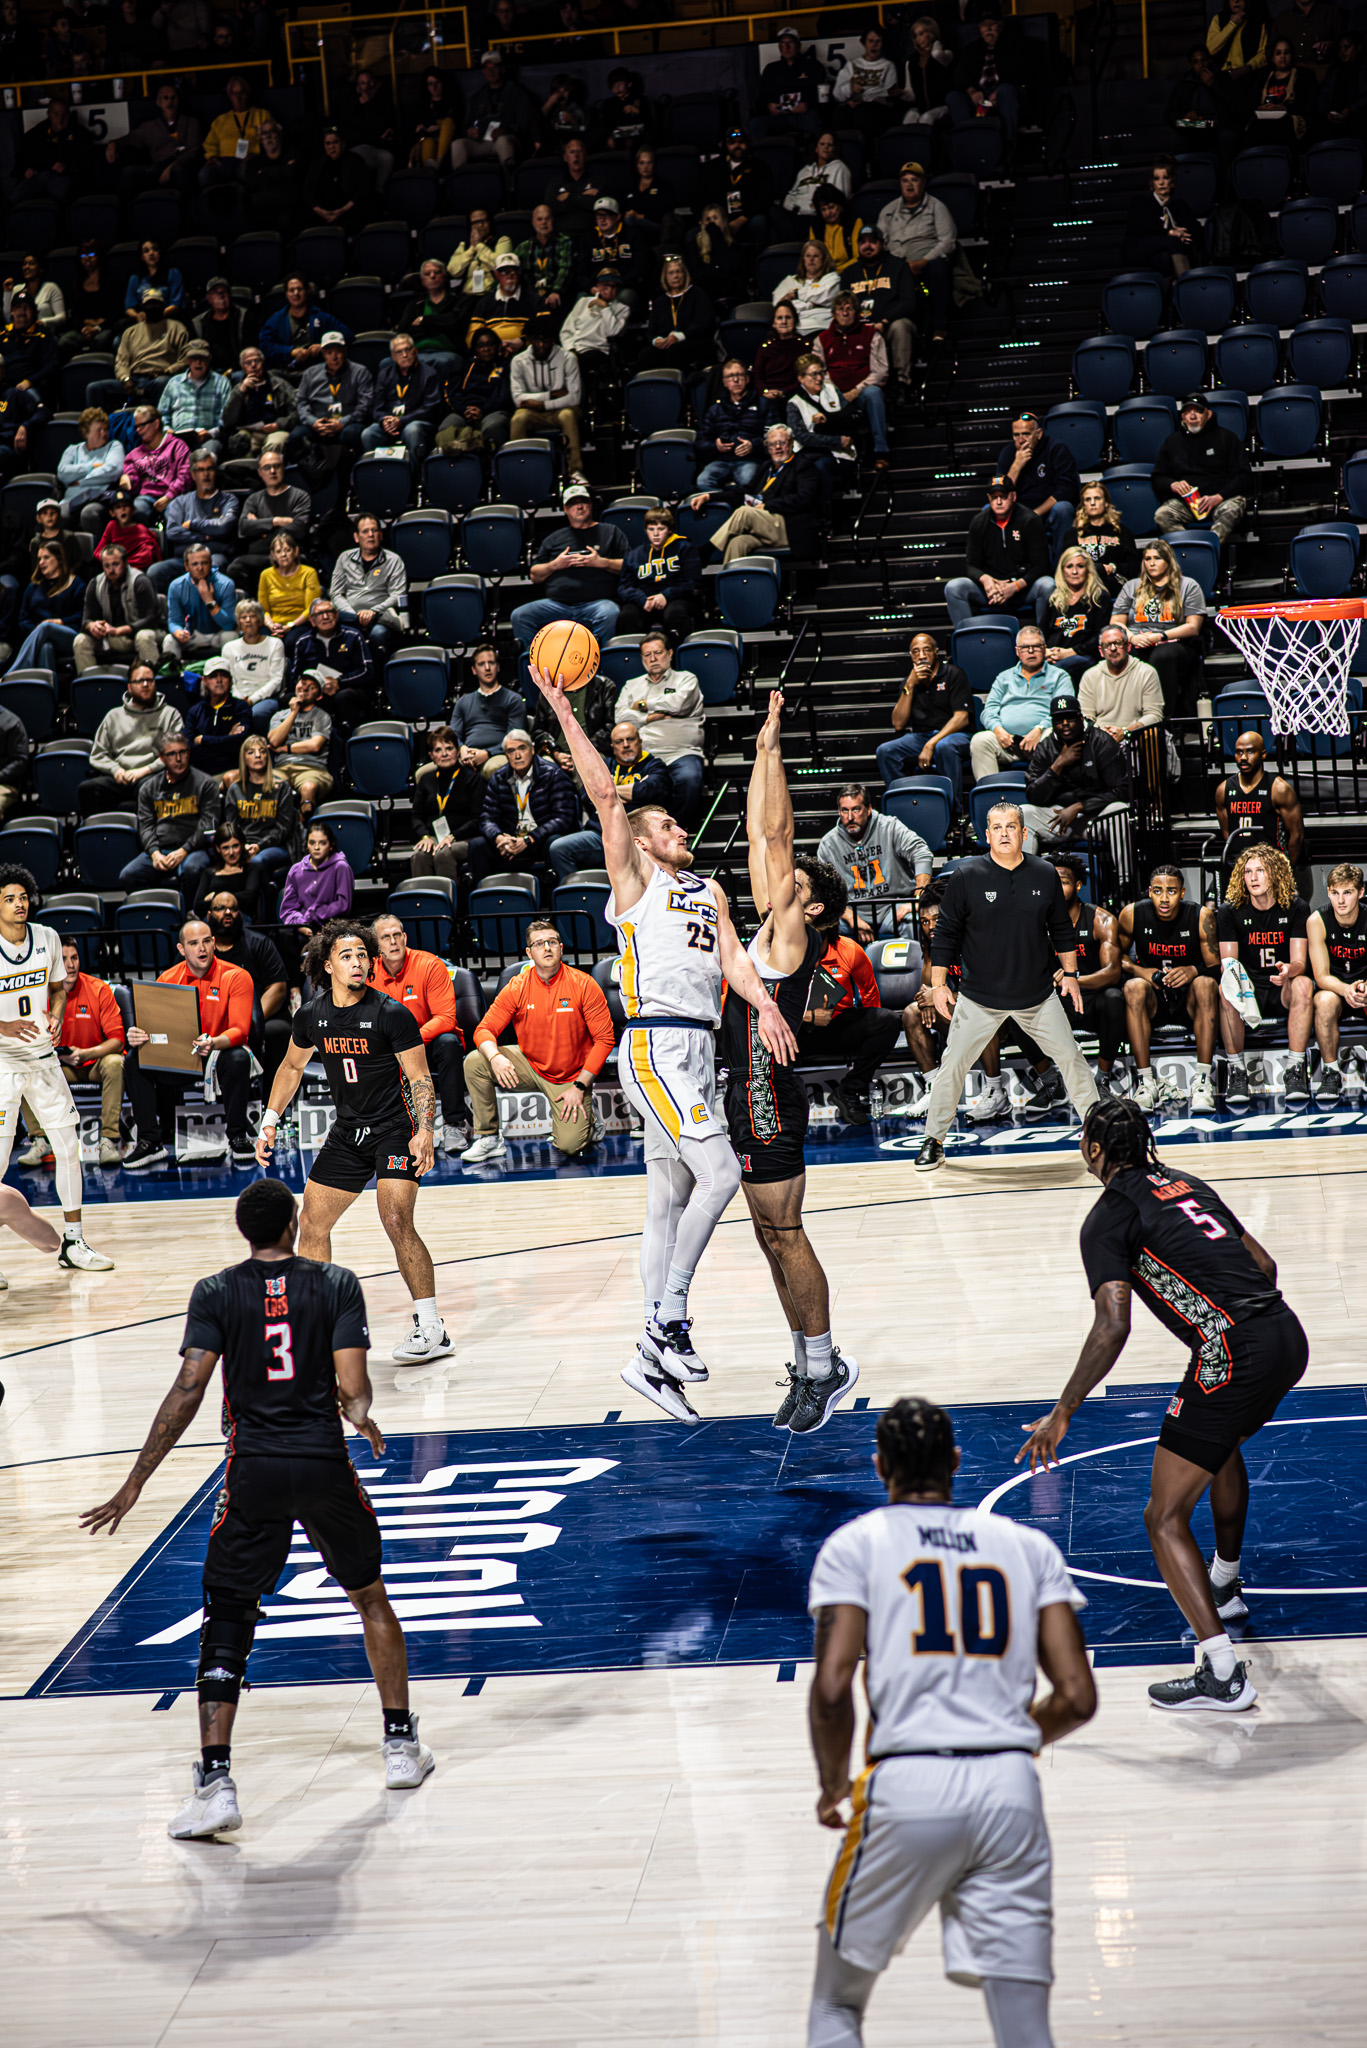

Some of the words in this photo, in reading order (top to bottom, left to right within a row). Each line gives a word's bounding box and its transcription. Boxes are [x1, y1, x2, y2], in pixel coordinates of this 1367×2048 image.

[637, 555, 681, 580] UTC
[1230, 801, 1262, 814] MERCER
[686, 920, 716, 953] 25
[1247, 930, 1285, 946] MERCER
[1148, 941, 1187, 958] MERCER
[1259, 947, 1276, 968] 15
[1329, 945, 1366, 960] MERCER
[0, 970, 47, 993] MOCS
[18, 995, 32, 1017] 0
[323, 1036, 370, 1055] MERCER
[342, 1057, 359, 1084] 0
[1176, 1198, 1228, 1240] 5
[264, 1321, 295, 1381] 3
[900, 1559, 1011, 1658] 10
